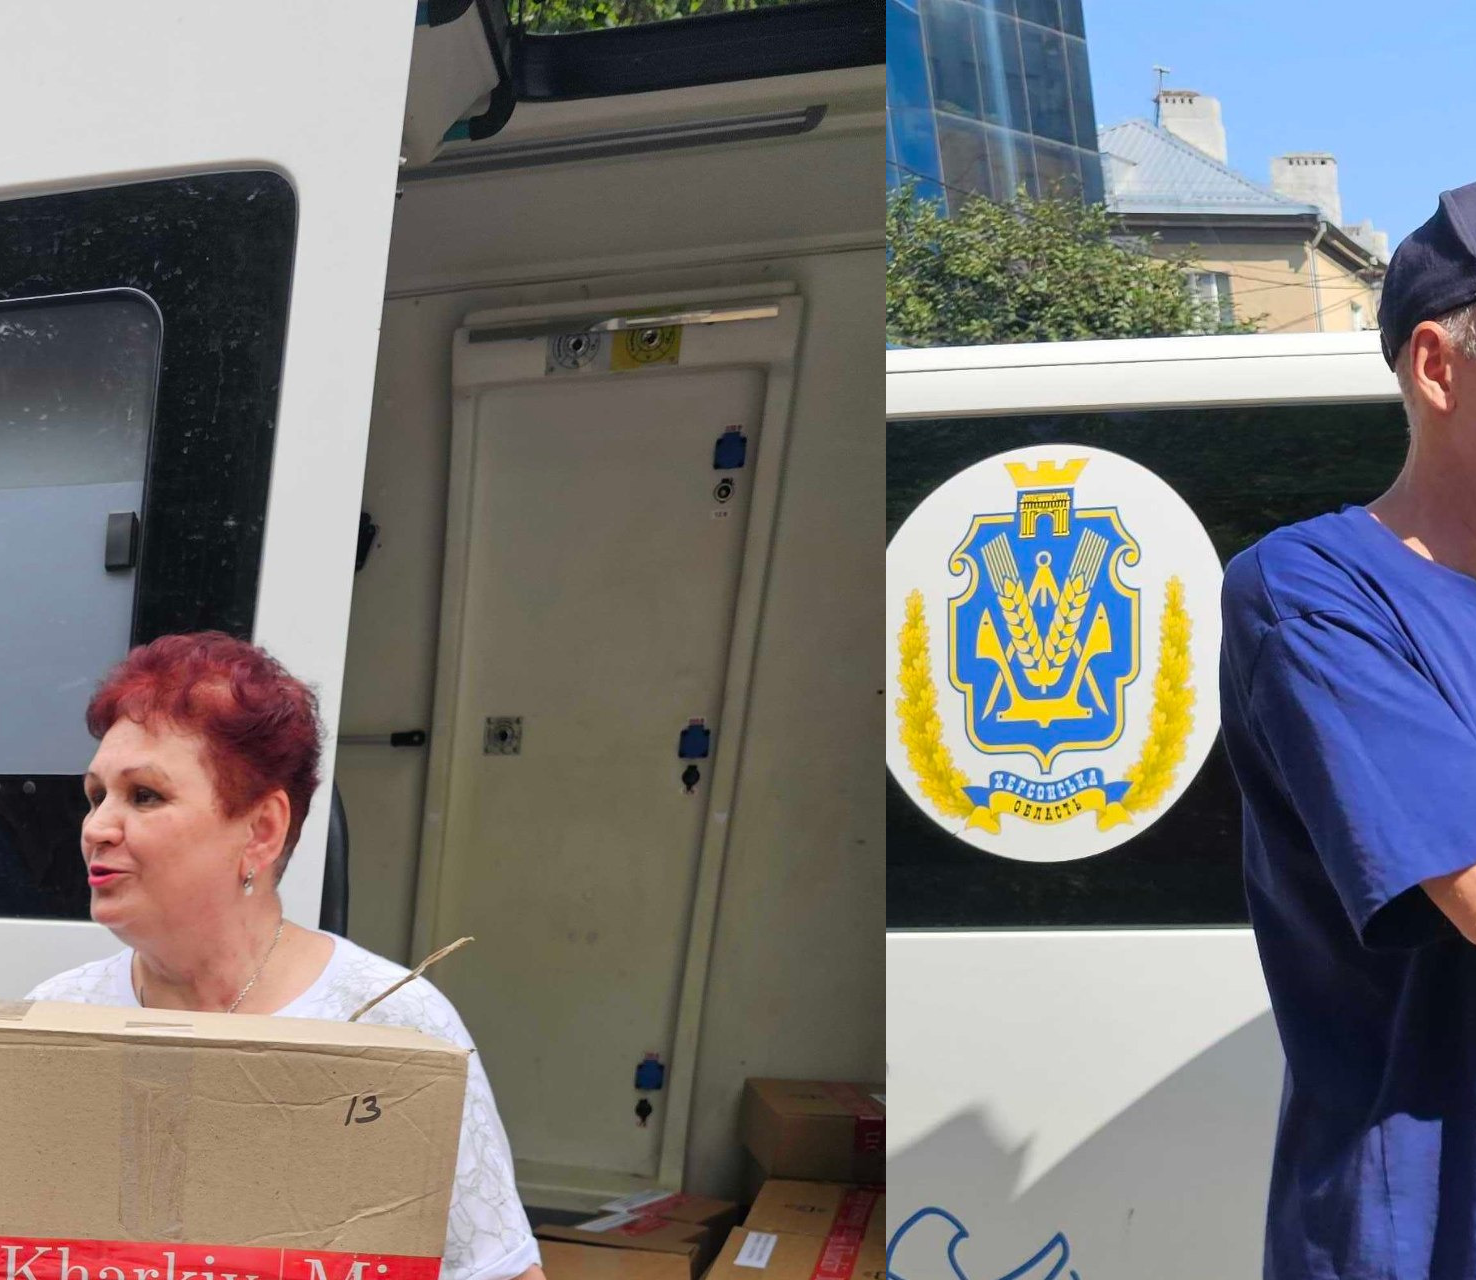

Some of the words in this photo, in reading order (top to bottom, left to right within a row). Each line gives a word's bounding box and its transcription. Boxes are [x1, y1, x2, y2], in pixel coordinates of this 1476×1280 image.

[994, 770, 1098, 800] ХЕРСОНСЬКА
[1013, 799, 1082, 820] ОБЛАСТЬ
[345, 1095, 381, 1126] 13
